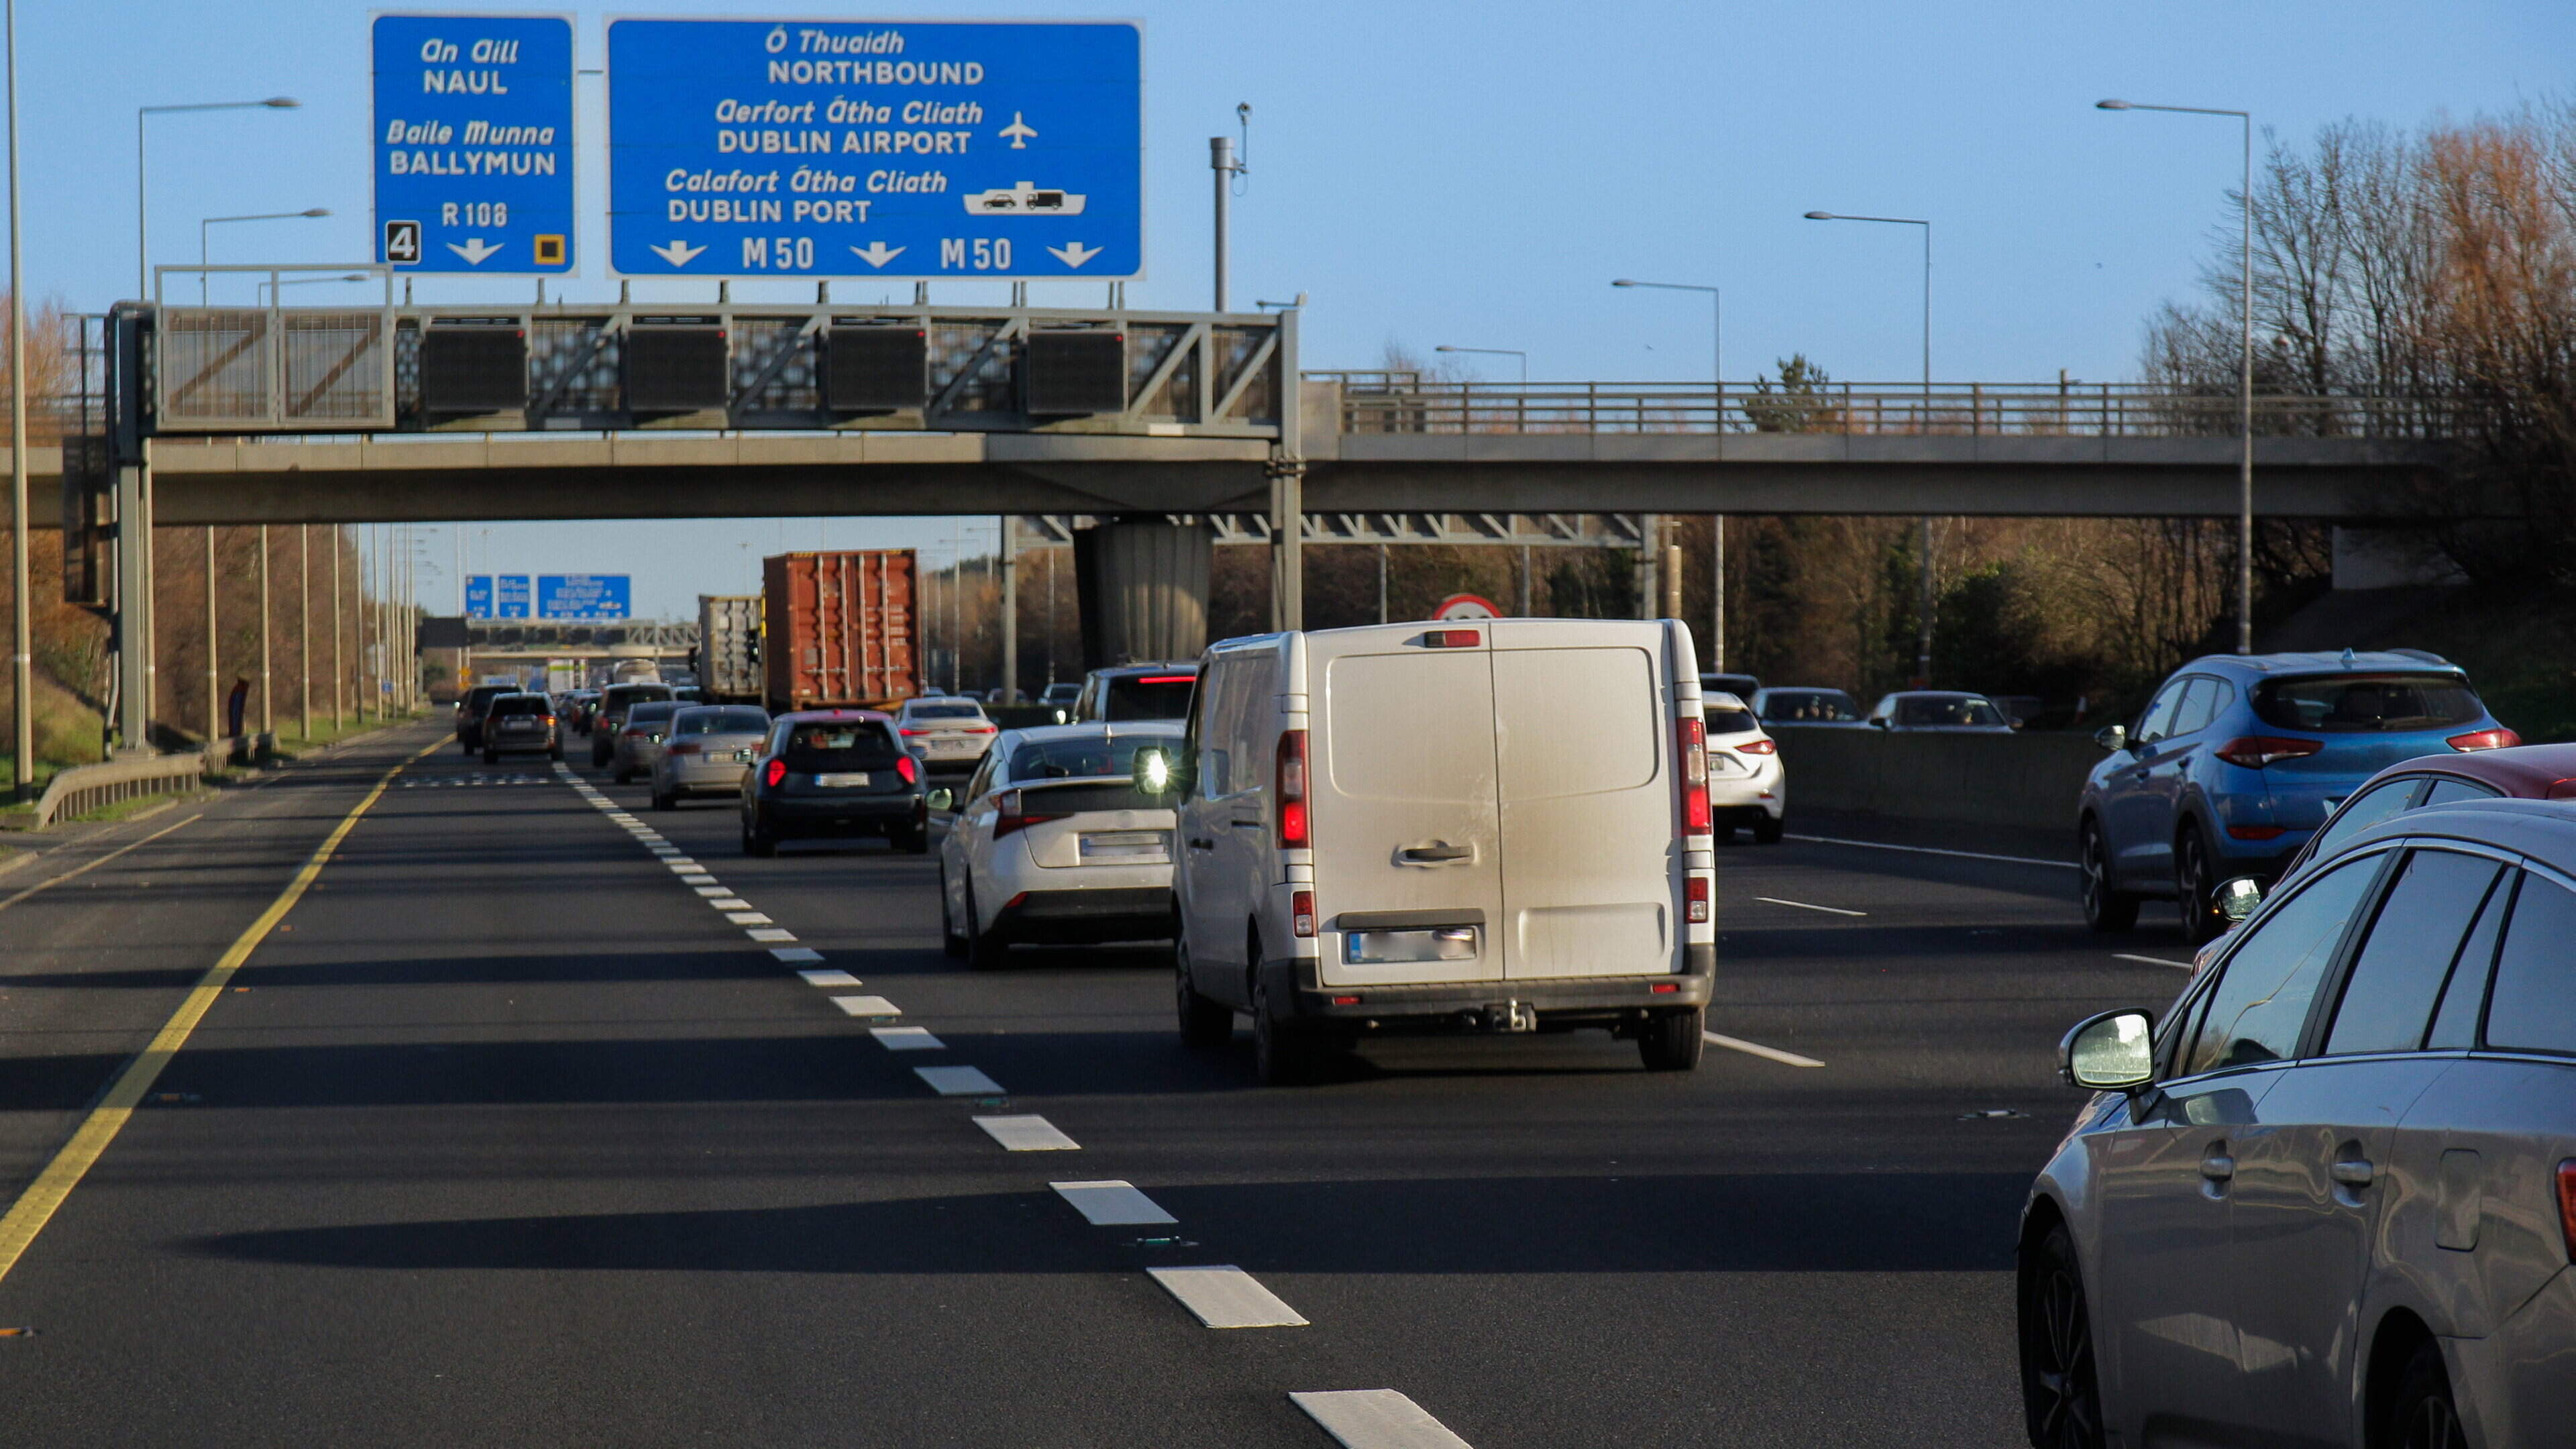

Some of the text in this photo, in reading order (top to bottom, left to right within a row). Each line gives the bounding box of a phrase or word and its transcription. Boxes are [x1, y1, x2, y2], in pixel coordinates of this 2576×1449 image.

[765, 24, 906, 54] Ó Thuaidh
[423, 70, 508, 95] NAUL
[768, 60, 984, 85] NORTHBOUND
[716, 95, 984, 125] Aerfort Átha Cliath
[386, 119, 555, 146] Baile Munna
[718, 129, 972, 155] DUBLIN AIRPORT
[390, 150, 555, 176] BALLYMUN
[666, 164, 948, 193] Calafort Átha Cliath
[668, 199, 872, 223] DUBLIN PORT
[388, 225, 416, 259] 4
